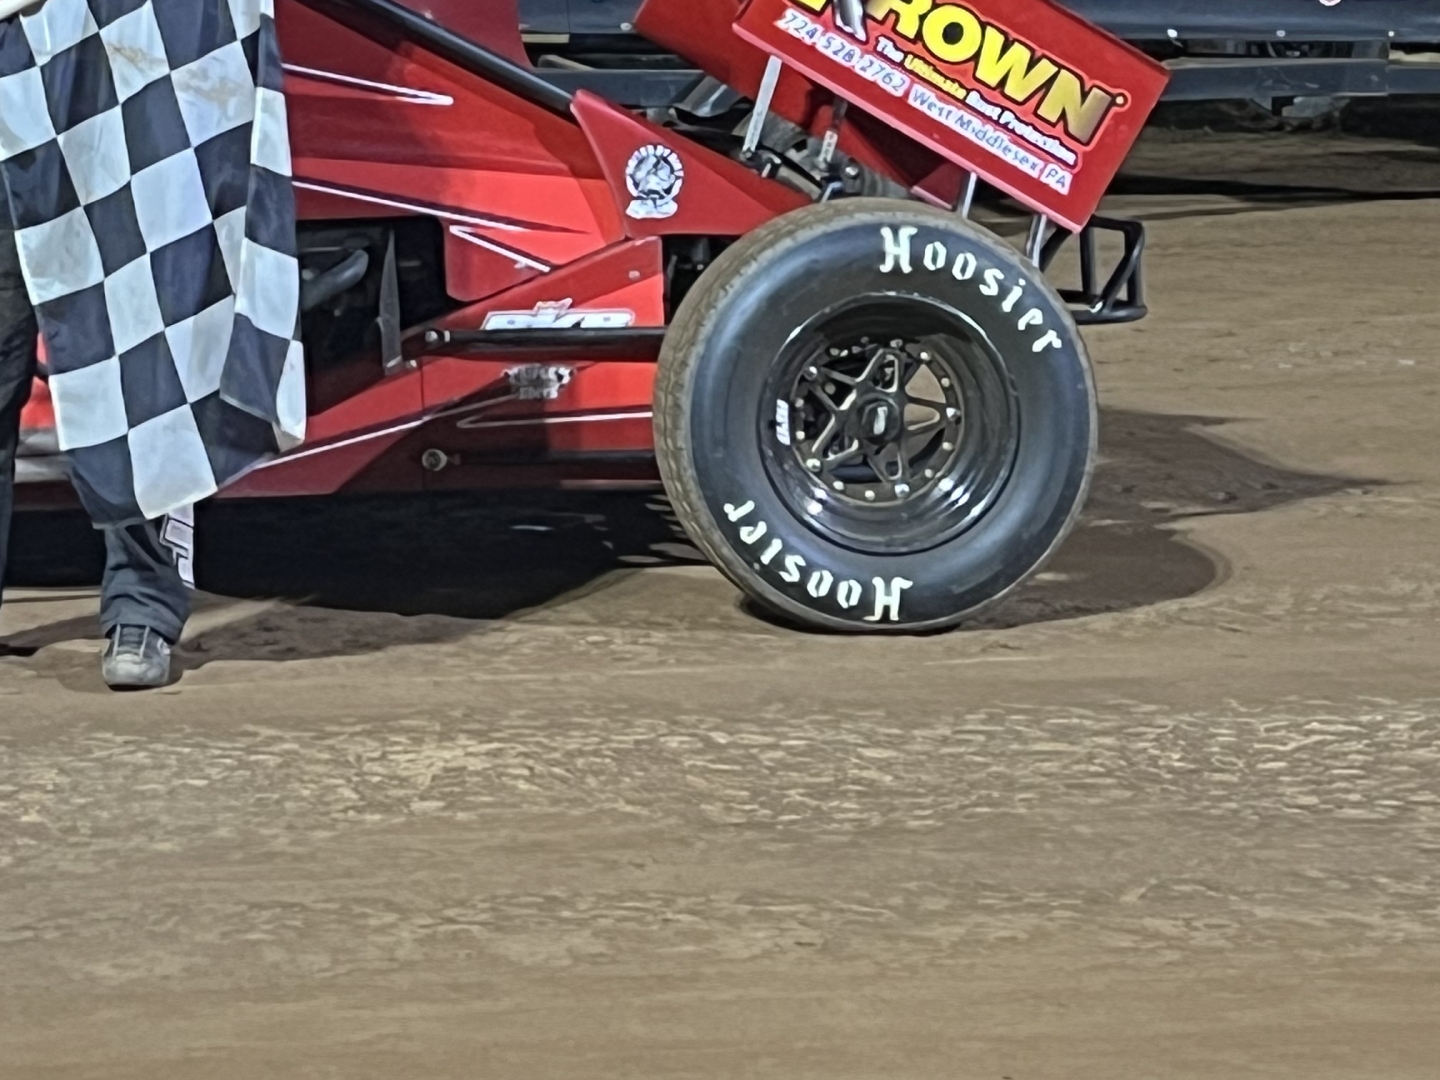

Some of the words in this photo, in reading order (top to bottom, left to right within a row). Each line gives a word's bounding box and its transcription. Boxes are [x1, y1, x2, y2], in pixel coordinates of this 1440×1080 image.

[913, 89, 953, 120] West
[955, 113, 1040, 172] Middlesex
[1044, 167, 1067, 189] PA
[879, 225, 1063, 353] Hoosier
[723, 499, 913, 621] Hoosier
